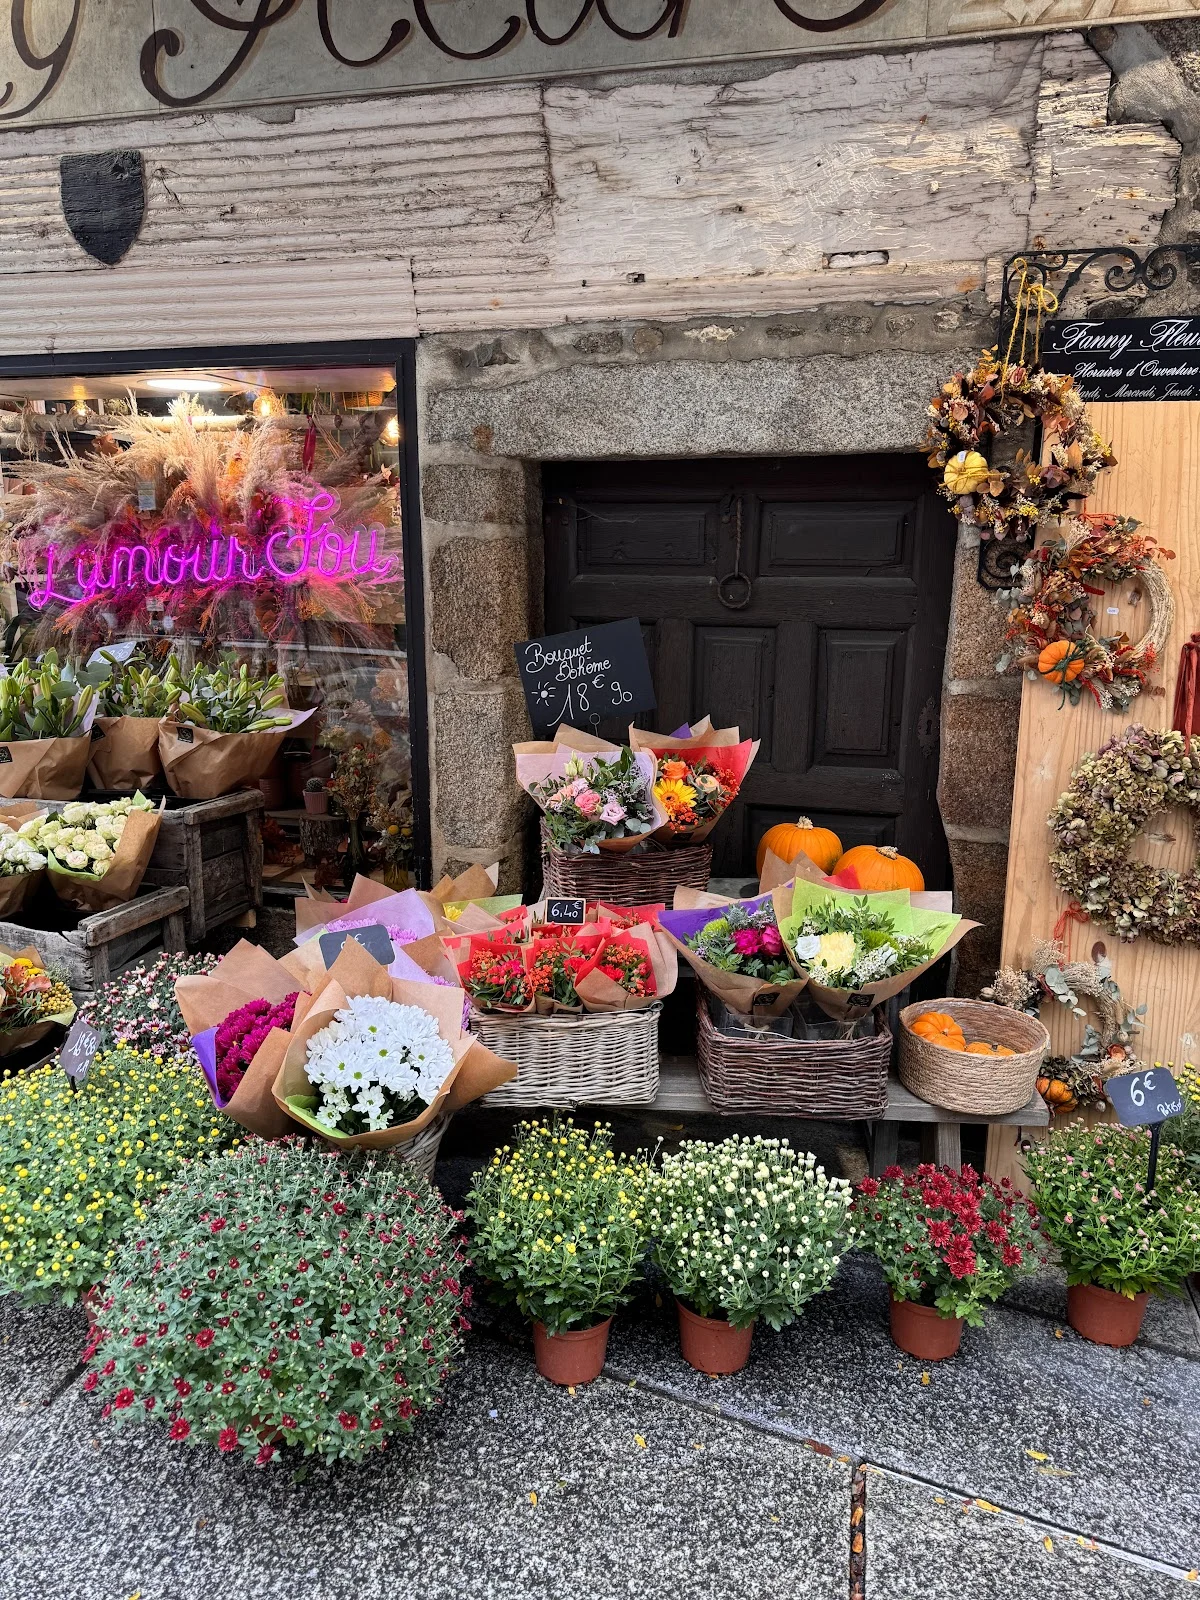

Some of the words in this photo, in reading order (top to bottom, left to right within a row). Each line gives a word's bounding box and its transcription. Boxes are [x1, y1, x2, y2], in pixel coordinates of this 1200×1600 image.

[1052, 321, 1133, 360] Fanny
[1140, 318, 1200, 352] Fleu
[1074, 362, 1123, 378] Horaires
[1105, 384, 1156, 399] Mercredi,
[266, 493, 392, 577] Fou
[525, 635, 592, 673] Bouquet
[551, 900, 582, 918] 6,40€
[1130, 1071, 1156, 1107] 6€
